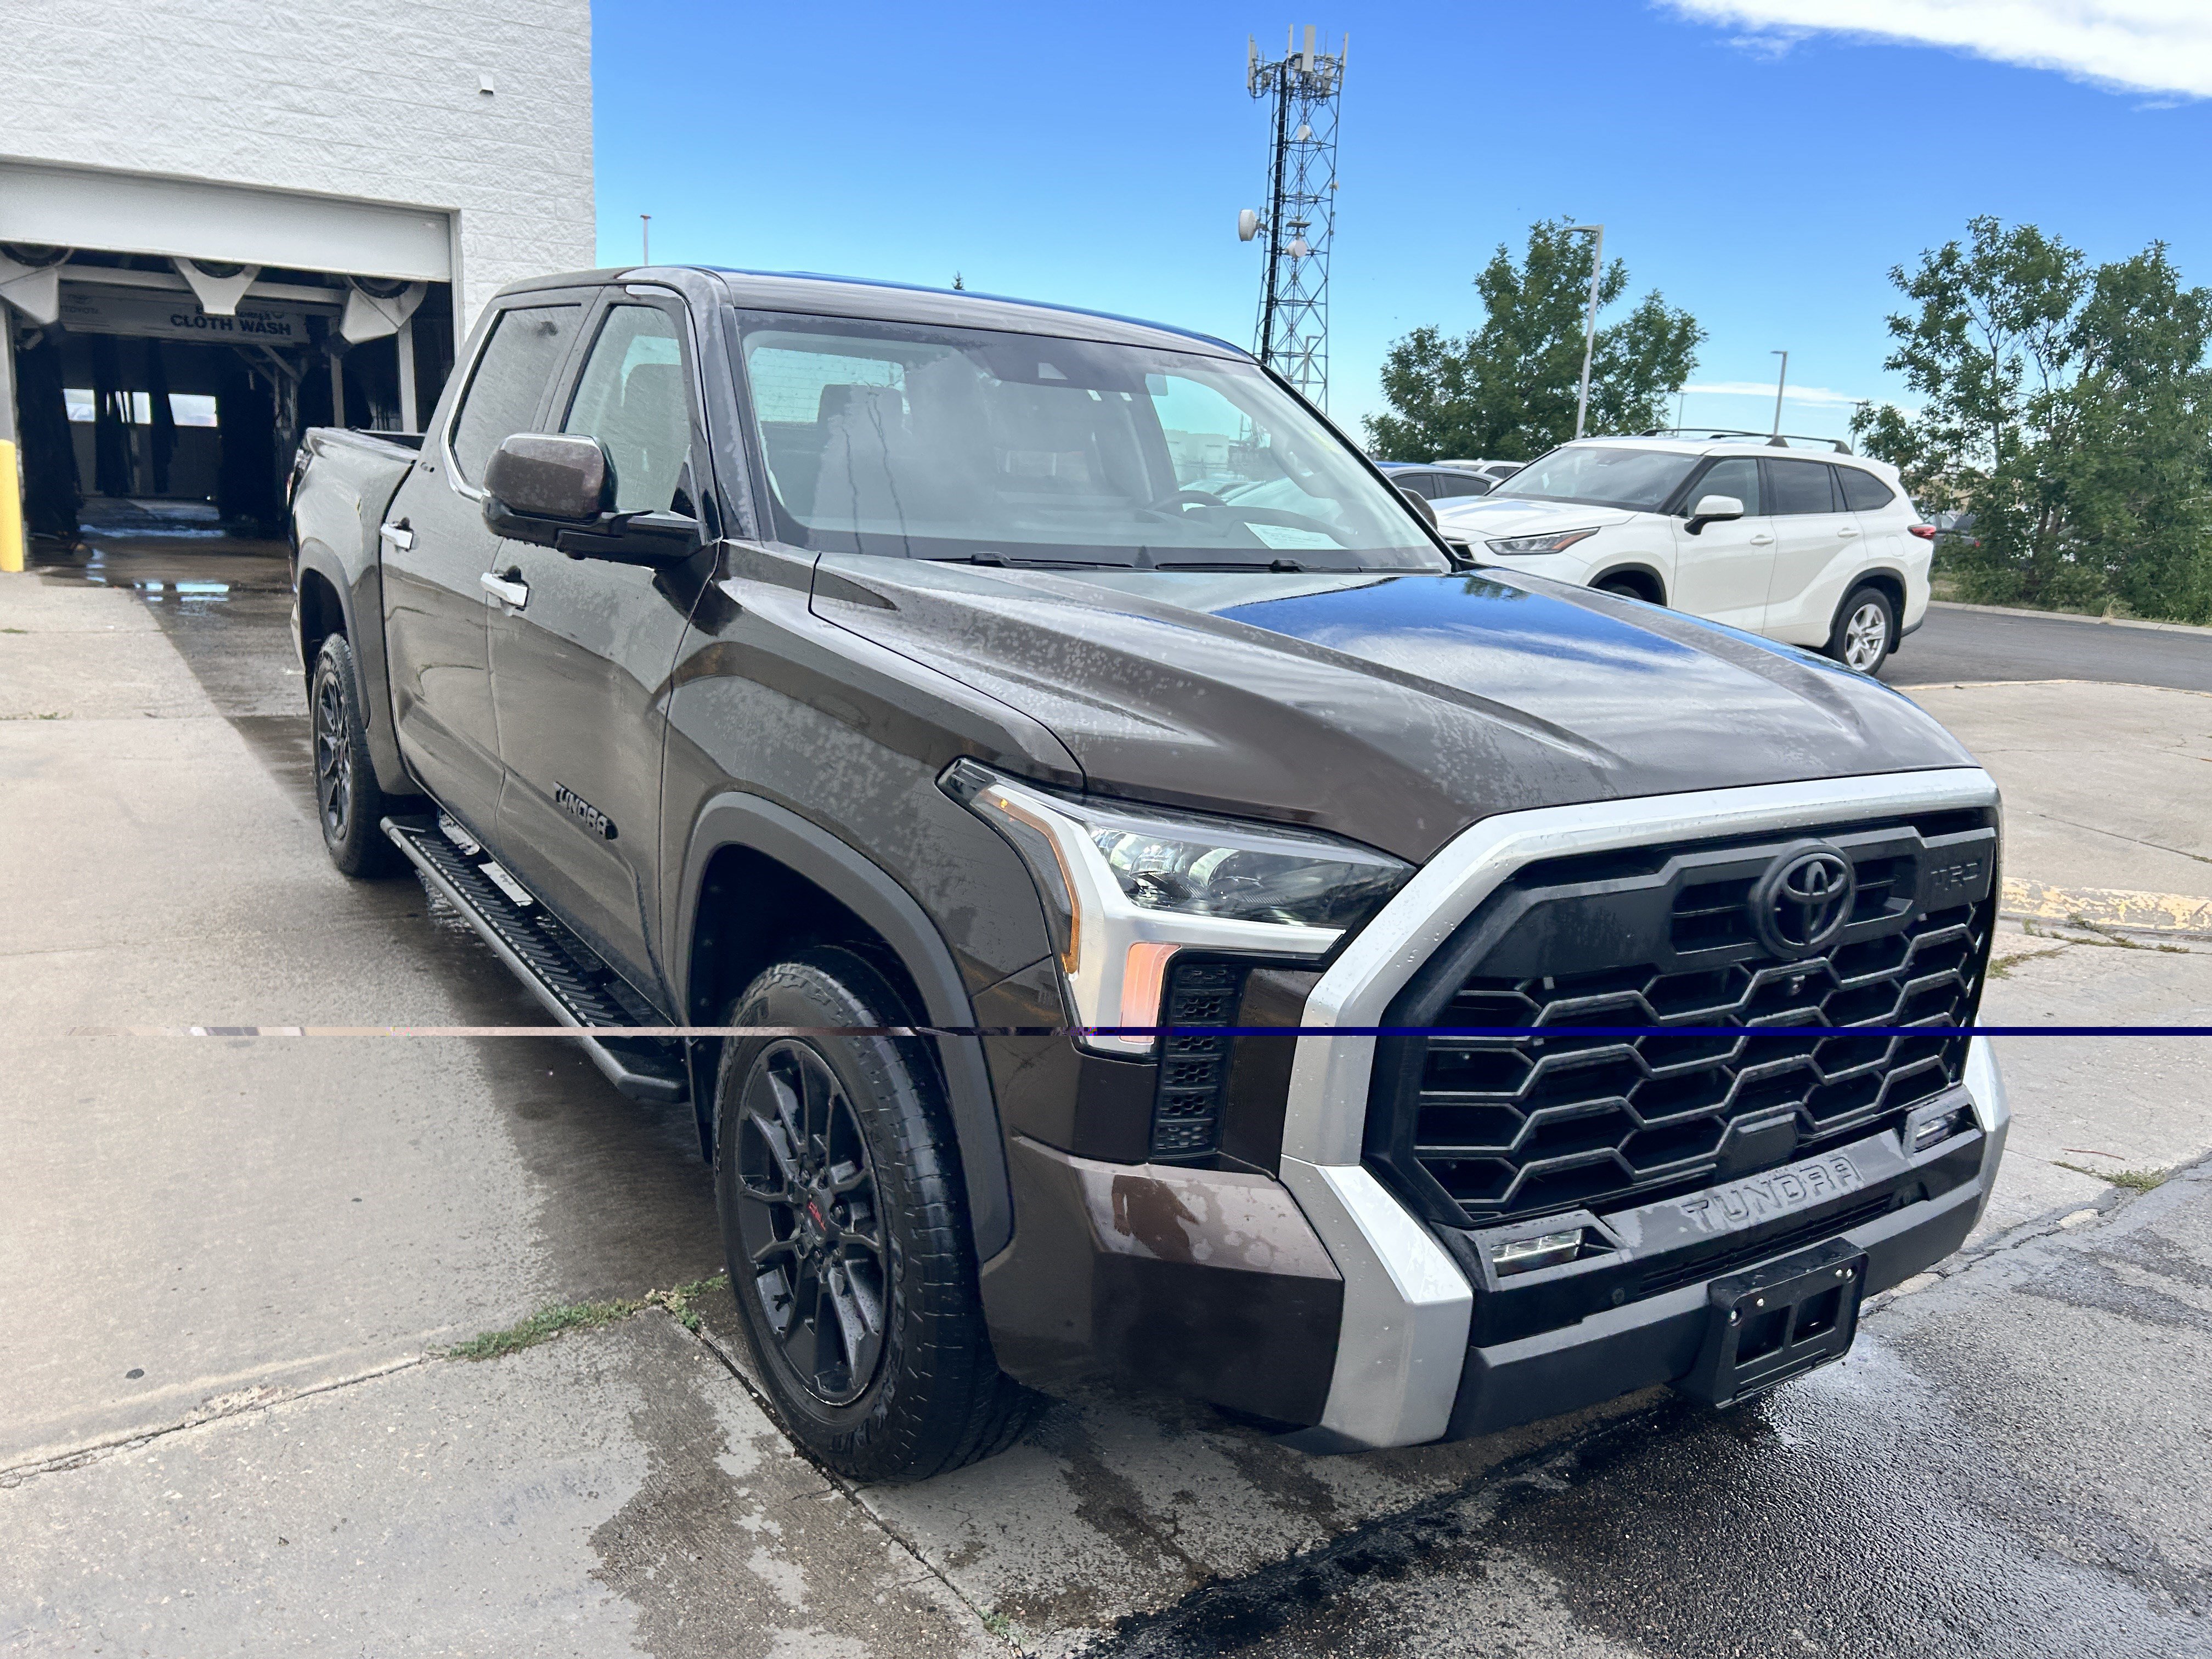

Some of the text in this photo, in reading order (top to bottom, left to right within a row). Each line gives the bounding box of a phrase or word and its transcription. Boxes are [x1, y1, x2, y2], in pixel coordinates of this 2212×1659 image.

[170, 313, 233, 330] CLOTH
[239, 318, 292, 335] WASH
[553, 781, 609, 836] TUNDRA
[1931, 859, 1982, 891] TRD
[1681, 1156, 1865, 1232] TUNDRA
